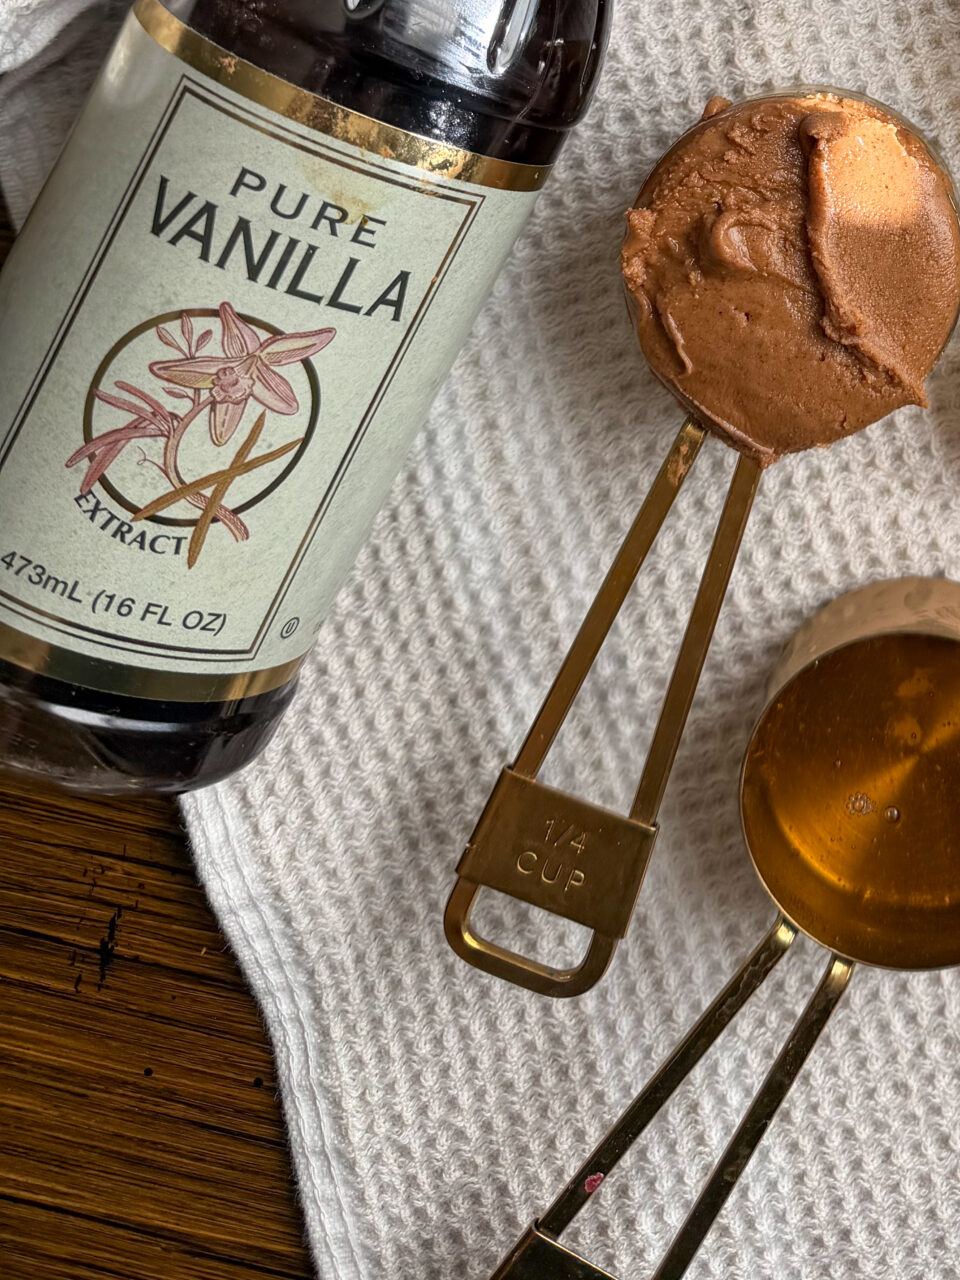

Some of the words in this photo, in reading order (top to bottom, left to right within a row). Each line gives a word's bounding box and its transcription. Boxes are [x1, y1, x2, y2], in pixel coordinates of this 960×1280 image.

[228, 166, 387, 248] PURE
[150, 175, 411, 322] VANILLA
[74, 490, 188, 556] EXTRACT
[1, 551, 83, 604] 473mL
[91, 589, 136, 618] (16
[140, 602, 173, 627] FL
[182, 610, 227, 637] OZ)
[516, 851, 586, 892] CUP
[545, 819, 587, 855] 1/4
